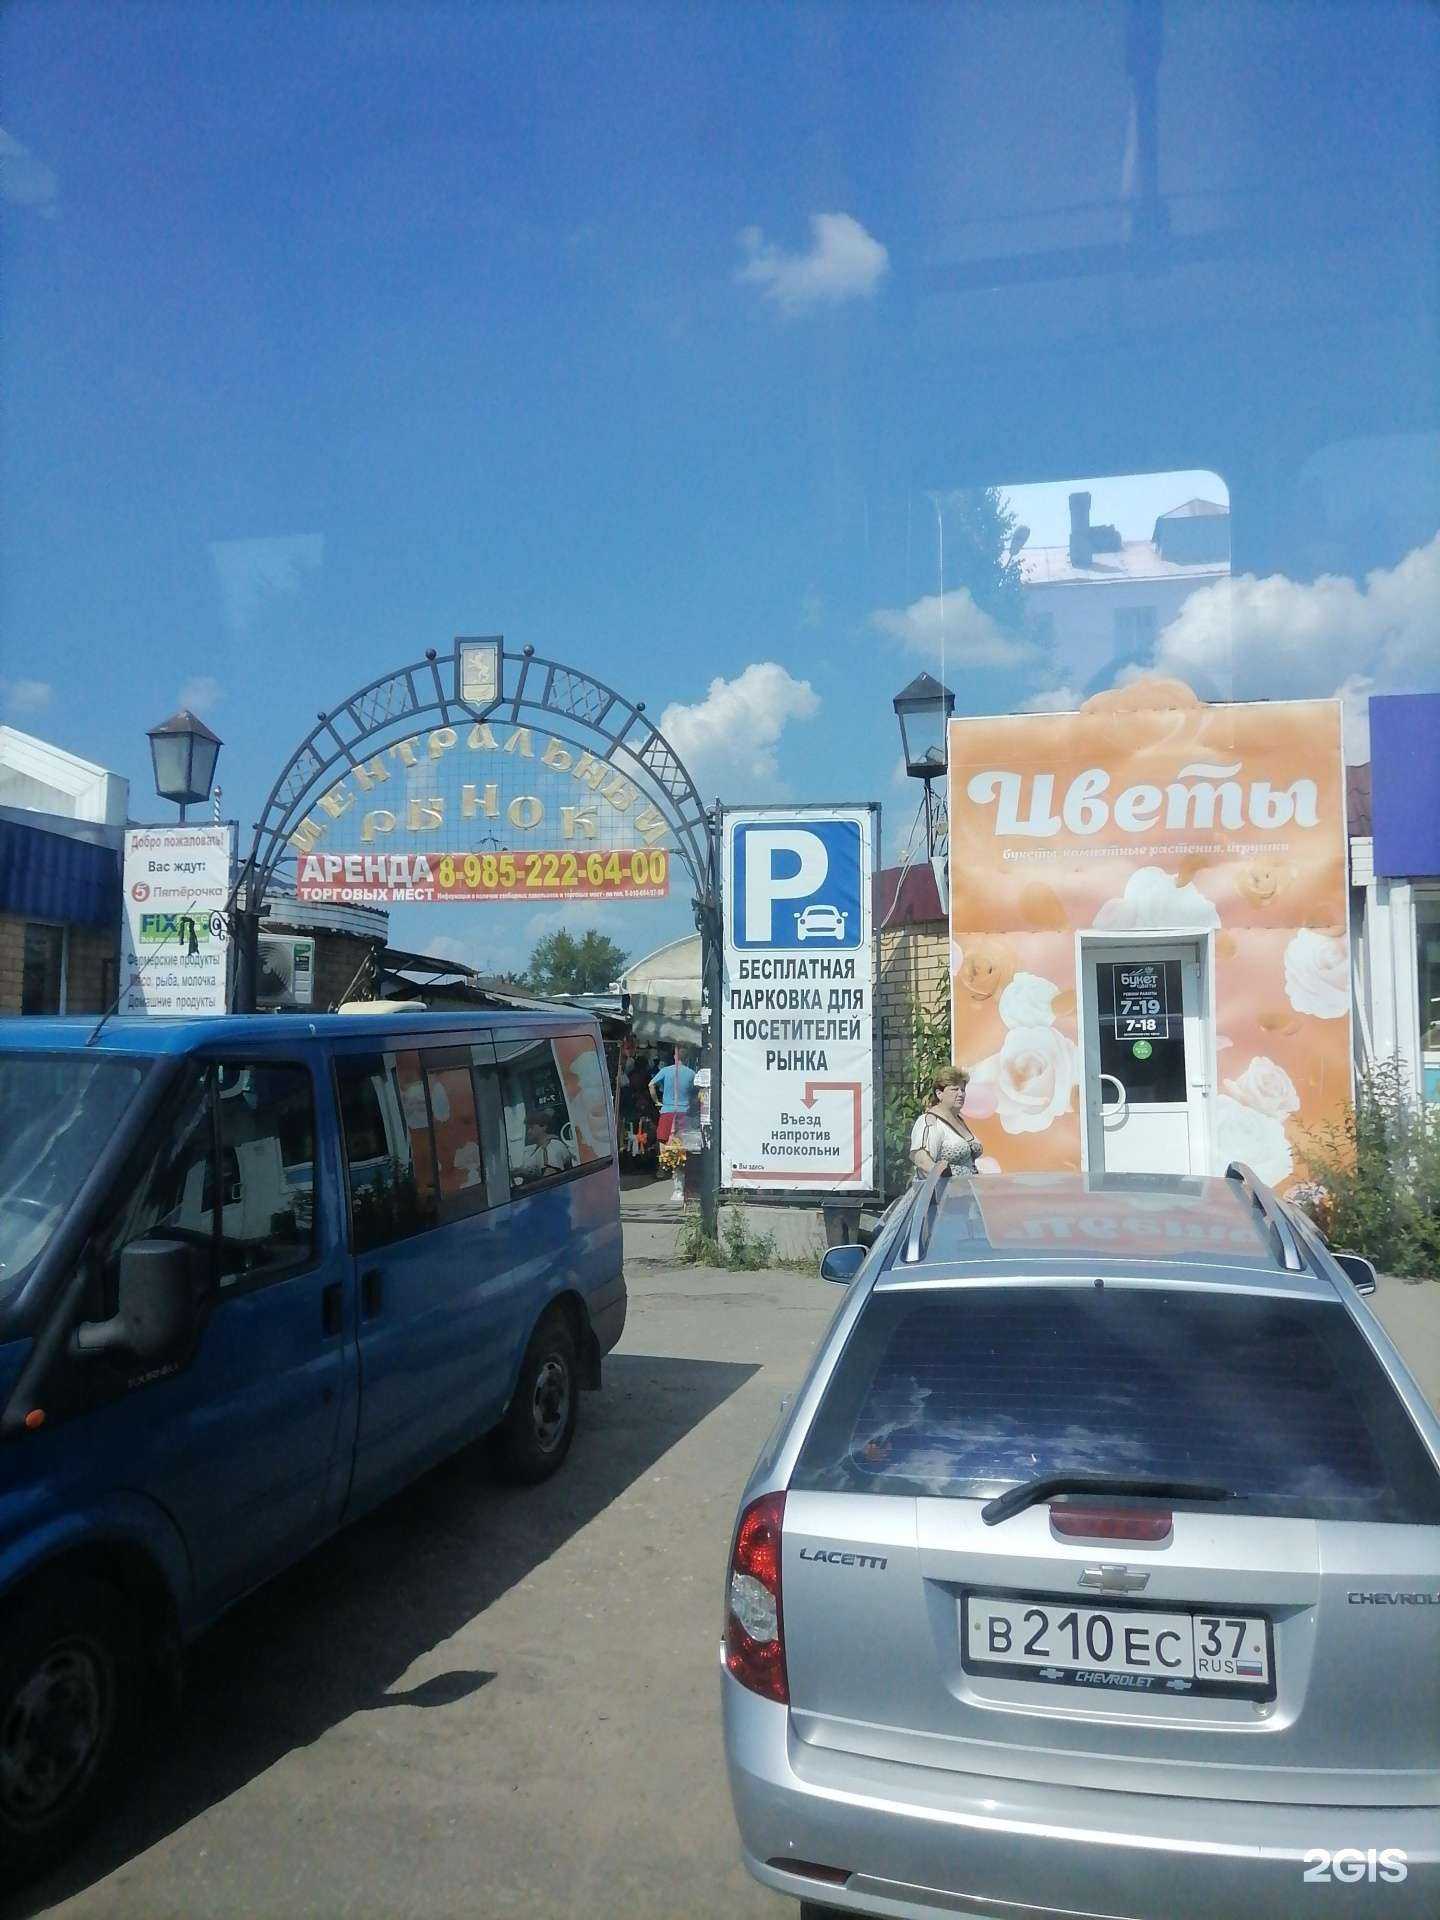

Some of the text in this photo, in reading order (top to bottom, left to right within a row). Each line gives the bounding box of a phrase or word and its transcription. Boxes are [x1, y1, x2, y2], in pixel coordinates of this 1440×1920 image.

[288, 723, 670, 853] ЦЕНТРАЛЬНЫЙ
[967, 761, 1320, 838] Цветы
[360, 783, 599, 843] РЫНОК
[131, 832, 224, 851] Добро пожаловать!
[148, 861, 206, 874] Вас ждут:
[301, 854, 435, 888] АРЕНДА
[439, 851, 666, 888] 8-985-222-64-00
[153, 886, 223, 899] Пятёрочка
[301, 888, 388, 900] ТОРГОВЫХ
[393, 888, 435, 900] МЕСТ
[180, 954, 220, 968] продукты
[739, 958, 855, 980] БЕСПЛАТНАЯ
[182, 975, 216, 986] молочка
[128, 994, 216, 1010] Домашние продукты
[731, 988, 864, 1013] ПАРКОВКА ДЛЯ
[1120, 999, 1160, 1015] 7-19
[733, 1014, 861, 1041] ПОСЕТИТЕЛЕЙ
[1126, 1019, 1156, 1032] 7-18
[766, 1050, 828, 1071] РЫНКА
[780, 1112, 821, 1127] Въезд
[771, 1130, 831, 1143] напротив
[761, 1143, 840, 1156] Колокольни
[800, 1547, 888, 1570] LACETTI
[1200, 1619, 1247, 1659] 37
[1199, 1658, 1235, 1674] RUS
[1074, 1671, 1155, 1688] CHEVROLET
